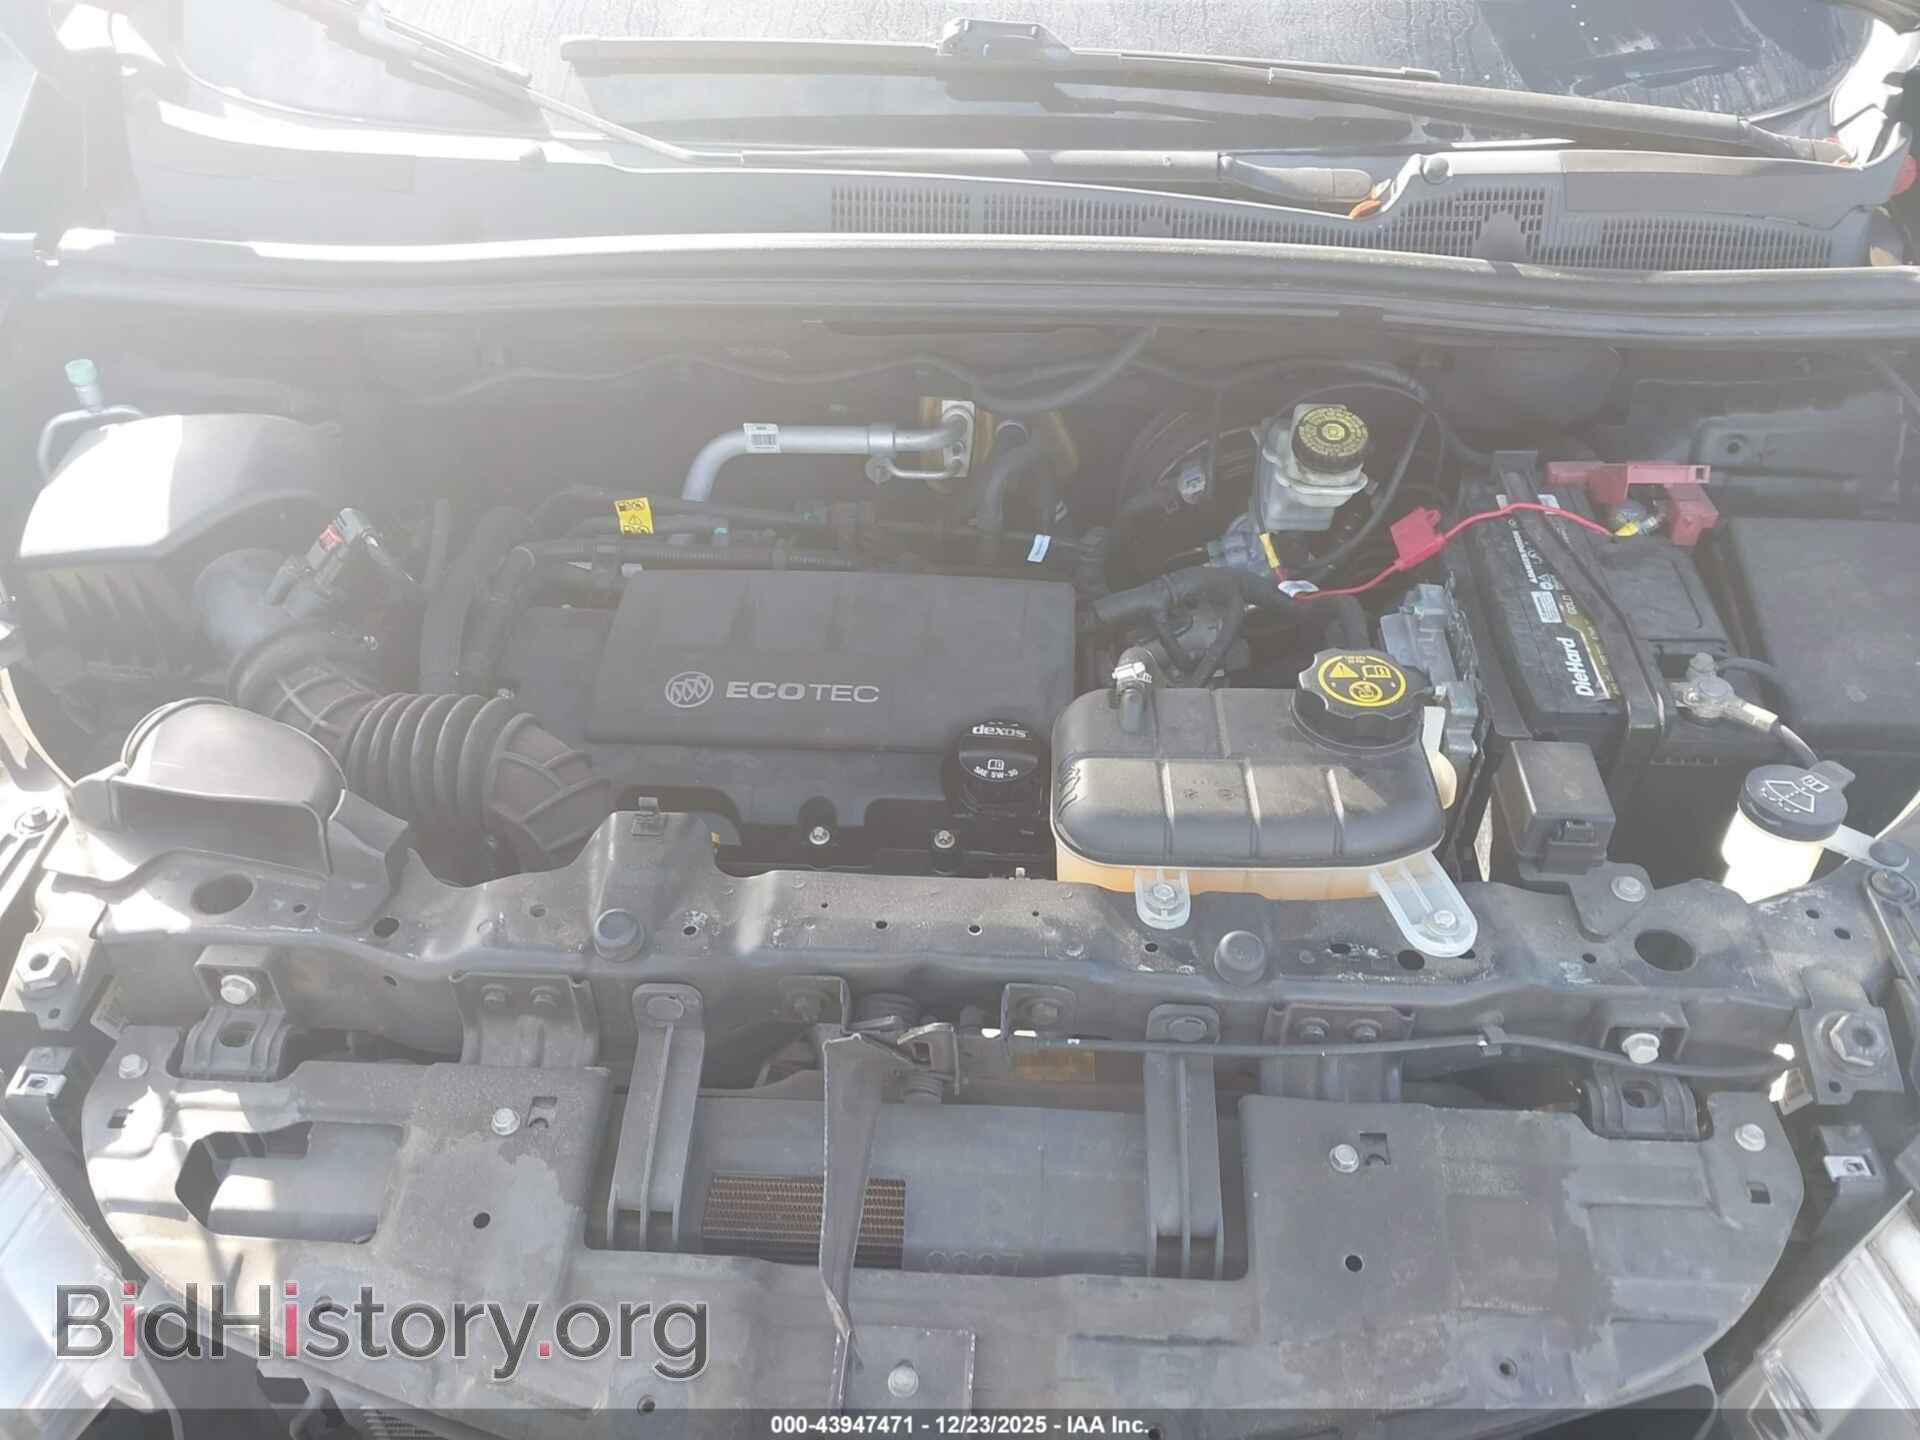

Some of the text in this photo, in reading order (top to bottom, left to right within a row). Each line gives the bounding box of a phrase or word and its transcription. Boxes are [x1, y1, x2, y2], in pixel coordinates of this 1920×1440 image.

[1556, 636, 1595, 698] DieHard
[725, 680, 880, 703] ECOTEC
[972, 724, 1027, 738] dexos
